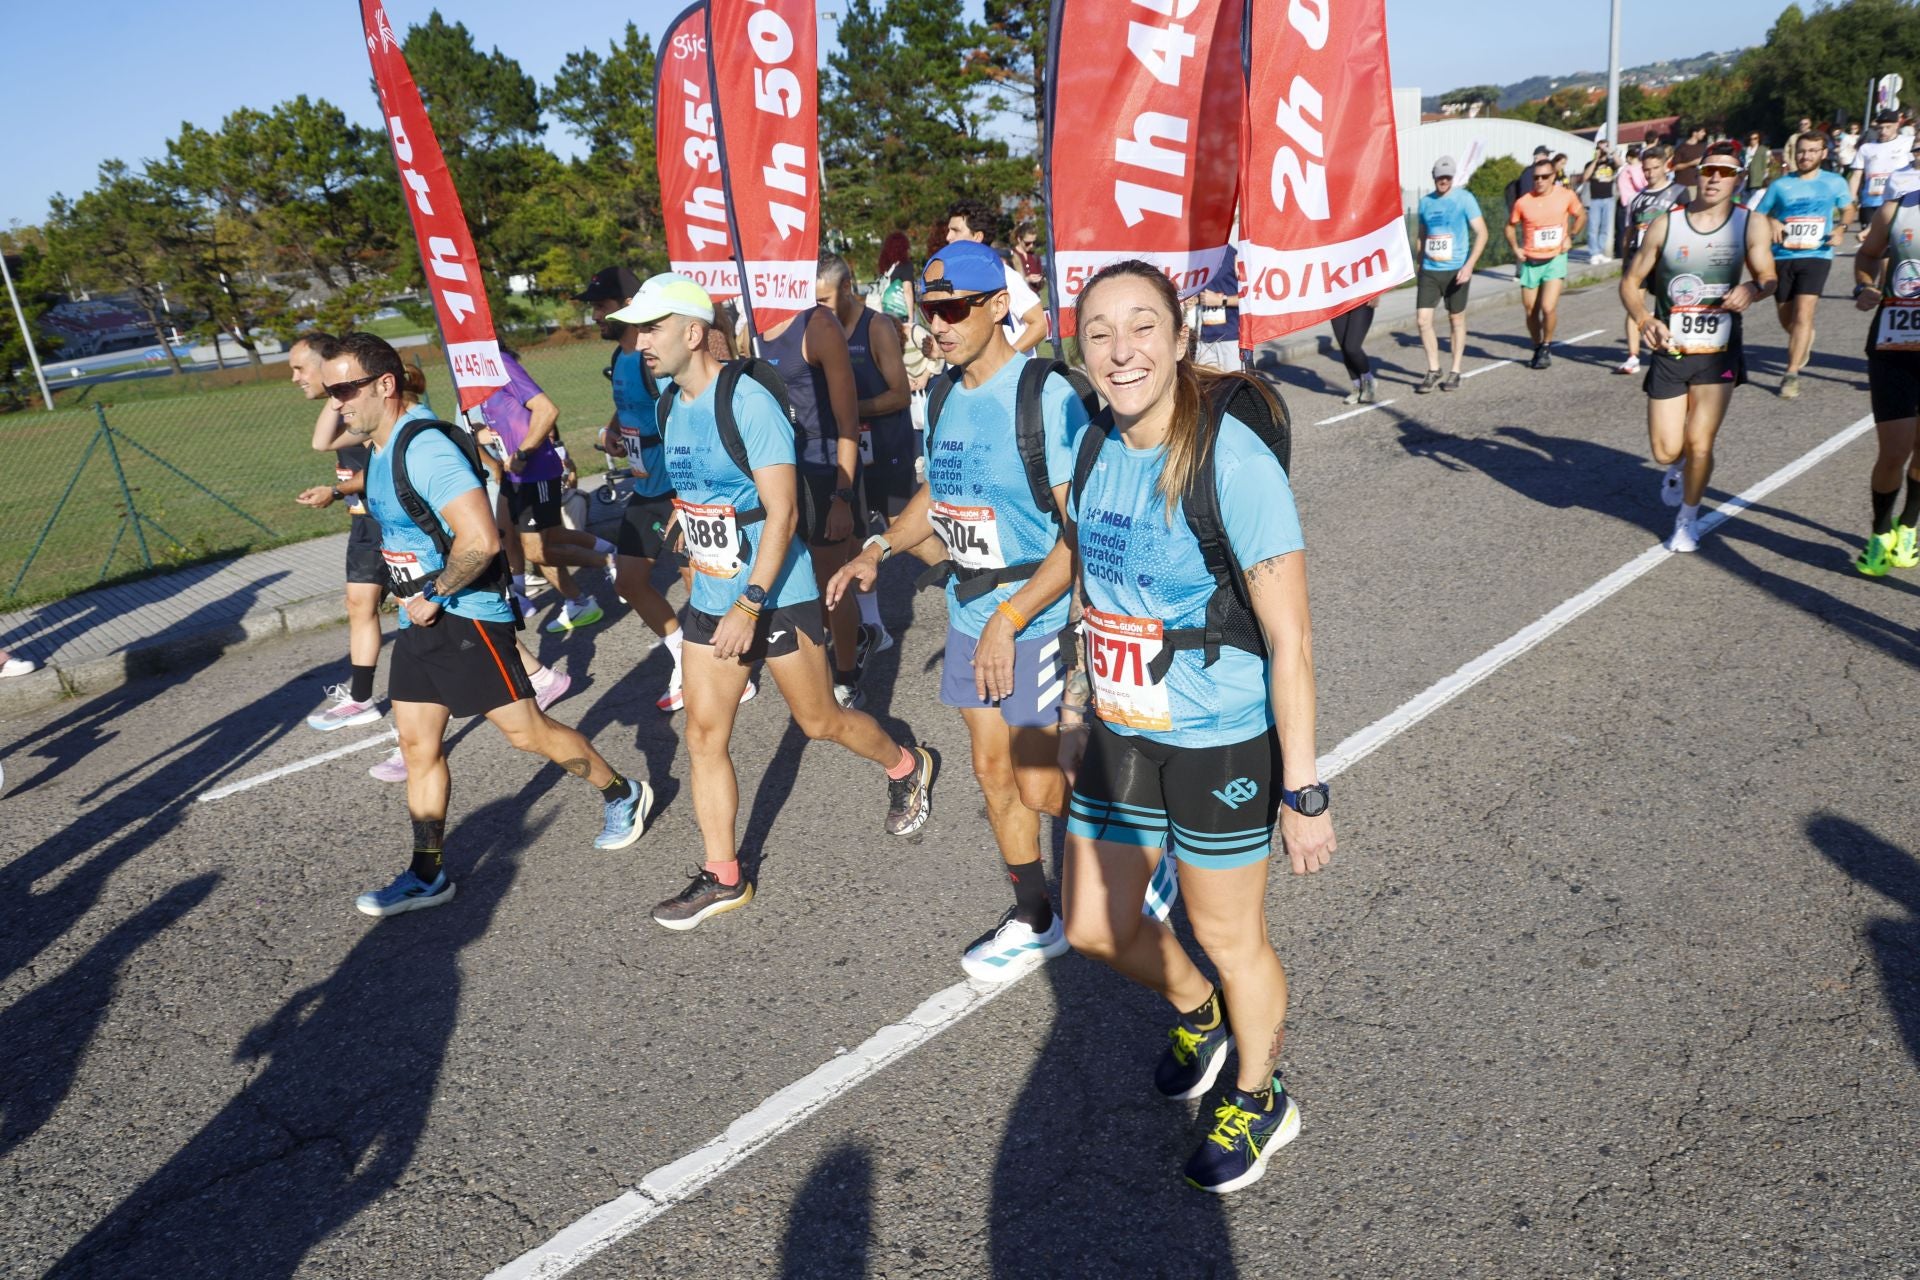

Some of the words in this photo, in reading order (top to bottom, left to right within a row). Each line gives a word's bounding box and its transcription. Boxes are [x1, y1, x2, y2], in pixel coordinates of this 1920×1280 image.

[1271, 75, 1330, 220] 2h
[1114, 111, 1188, 228] 1h
[763, 142, 806, 240] 1h
[685, 186, 727, 251] 1h
[1541, 231, 1557, 240] 912
[1790, 224, 1818, 236] 1078
[1682, 316, 1719, 334] 999
[674, 445, 691, 455] MBA
[941, 441, 964, 452] MBA
[670, 459, 692, 470] media
[933, 455, 963, 470] media
[1101, 510, 1132, 531] MBA
[1089, 529, 1126, 552] media
[1087, 561, 1124, 586] GIJÓN
